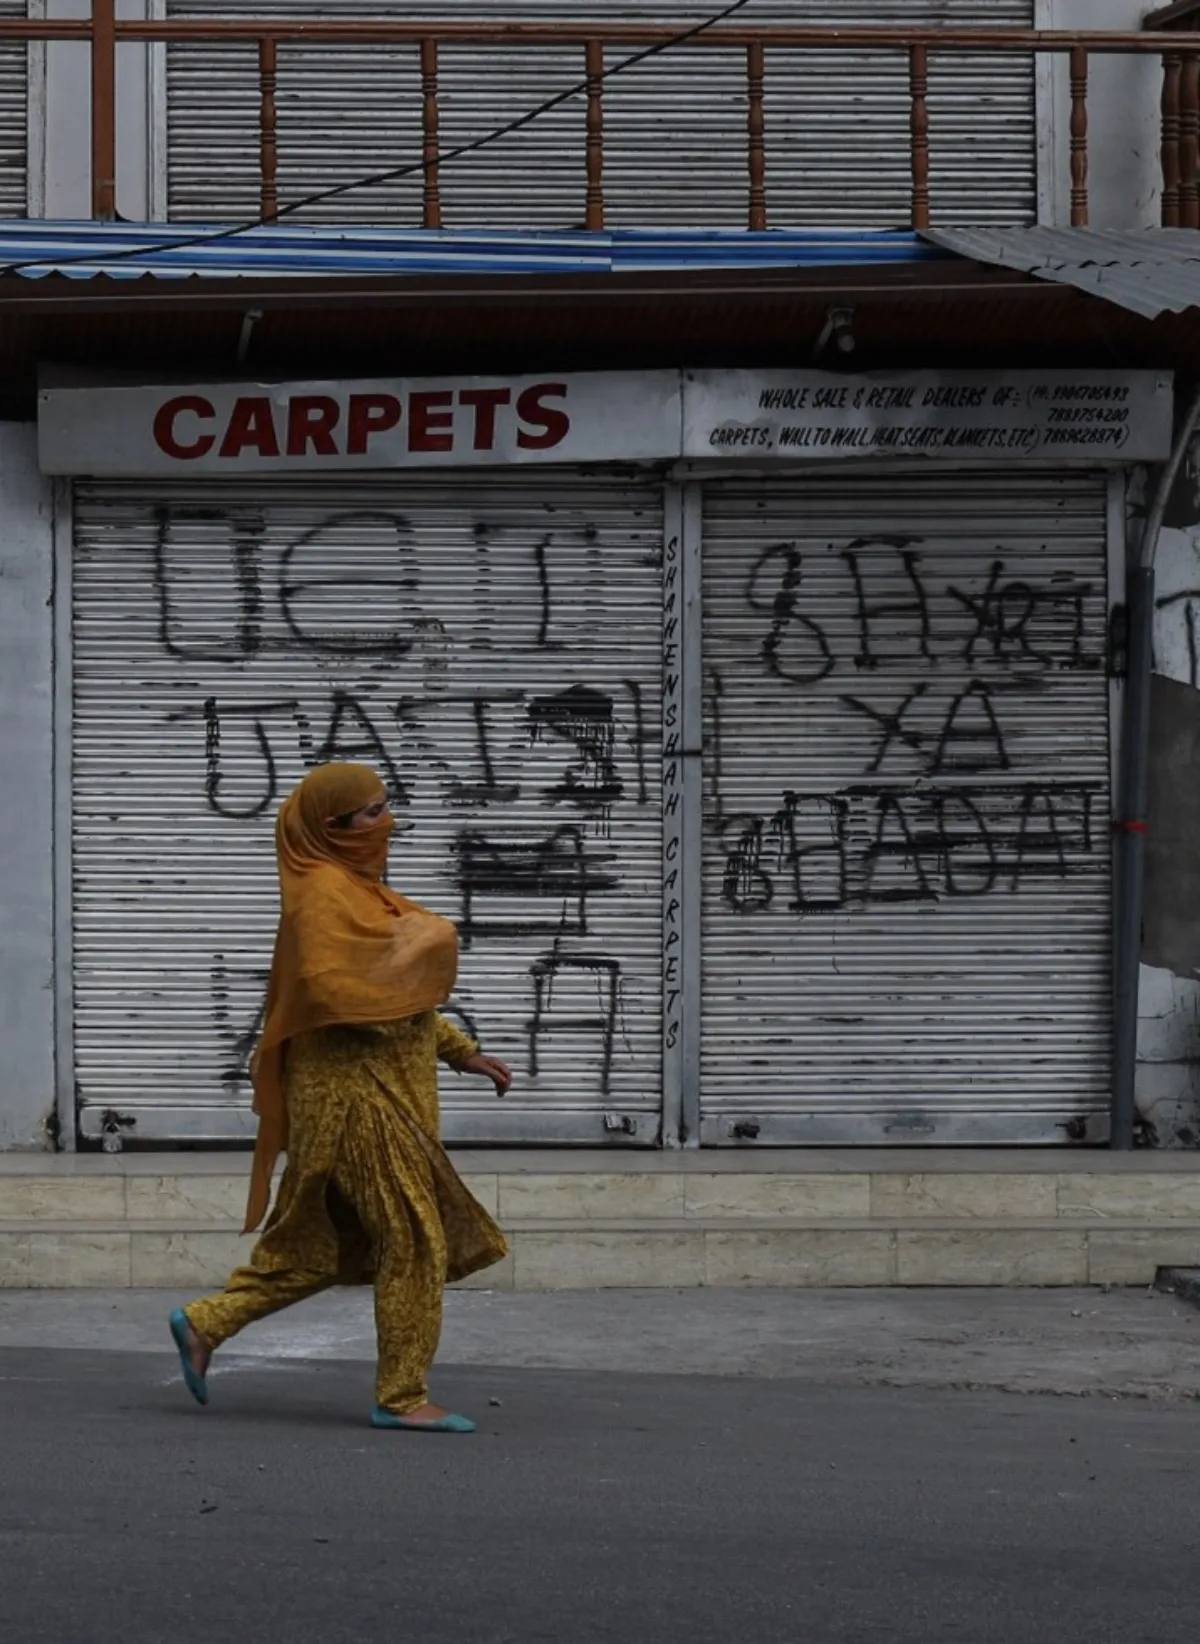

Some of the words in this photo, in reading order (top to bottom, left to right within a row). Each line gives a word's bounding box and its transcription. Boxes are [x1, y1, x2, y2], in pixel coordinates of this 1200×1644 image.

[152, 382, 571, 461] CARPETS
[758, 387, 810, 409] WHOLE
[811, 386, 849, 409] SALE
[865, 386, 916, 409] RETAIL
[921, 386, 987, 408] DEALERS
[664, 535, 679, 817] SHAHENSHAH
[664, 836, 680, 1050] CARPETS
